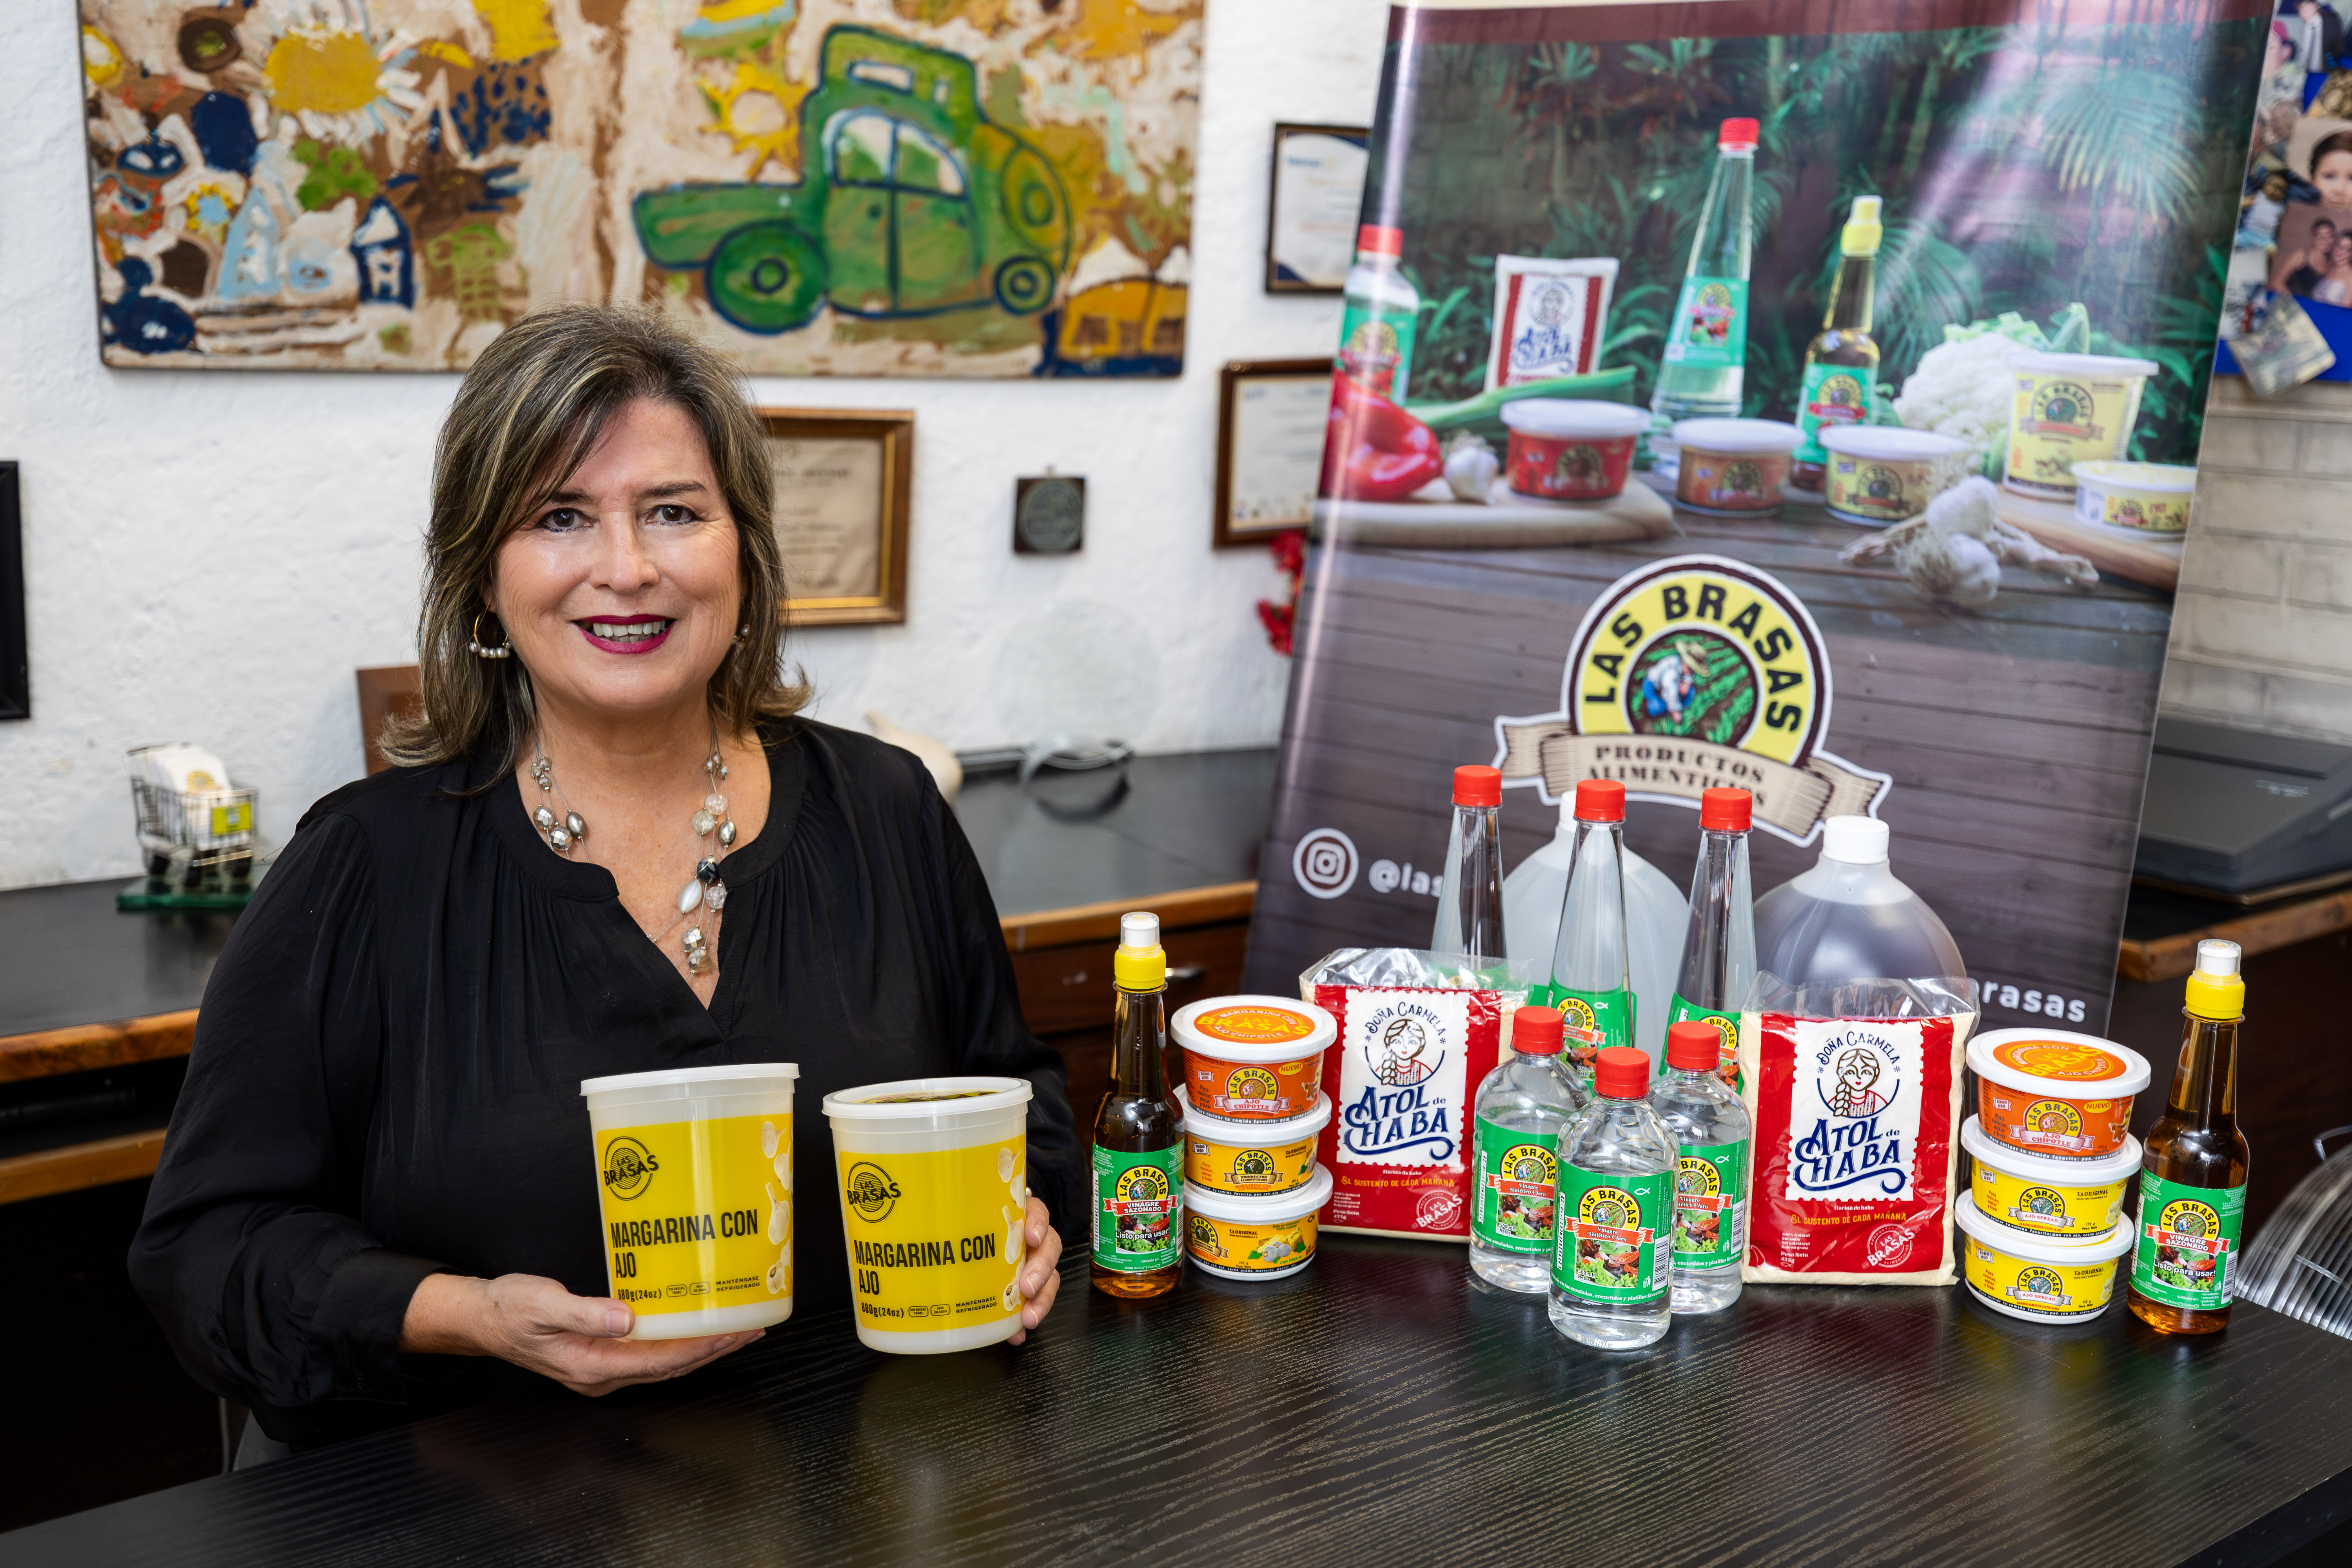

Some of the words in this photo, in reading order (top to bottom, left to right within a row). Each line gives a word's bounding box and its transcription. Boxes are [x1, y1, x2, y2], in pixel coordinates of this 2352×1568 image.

[1586, 613, 1643, 703] LAS
[1662, 584, 1803, 732] BRASAS
[1596, 745, 1765, 783] PRODUCTOS
[1197, 1016, 1310, 1035] BRASAS
[1220, 1010, 1281, 1018] MARGARINA
[1282, 1015, 1297, 1025] CON
[1365, 1007, 1394, 1034] DOÑA
[1398, 1002, 1446, 1036] CARMELA
[1213, 1025, 1229, 1034] AJO
[1710, 1019, 1735, 1044] BRASAS
[1816, 1038, 1843, 1065] DOÑA
[1846, 1031, 1901, 1064] CARMELA
[1281, 1064, 1302, 1073] NUEVO
[2020, 1046, 2105, 1076] BRASAS
[1230, 1076, 1241, 1094] LAS
[1244, 1070, 1275, 1095] BRASAS
[1345, 1085, 1430, 1128] ATOL
[2028, 1107, 2042, 1126] LAS
[2045, 1103, 2078, 1132] BRASAS
[1344, 1107, 1450, 1149] HABA
[1795, 1117, 1882, 1160] ATOL
[2031, 1136, 2071, 1147] CHIPOTLE
[604, 1154, 659, 1187] BRASAS
[617, 1156, 631, 1167] LAS
[1237, 1156, 1246, 1171] LAS
[1247, 1152, 1272, 1171] BRASAS
[1504, 1153, 1517, 1174] LAS
[1521, 1148, 1555, 1180] BRASAS
[1795, 1140, 1901, 1183] HABA
[859, 1180, 874, 1190] LAS
[1120, 1176, 1132, 1196] LAS
[1134, 1169, 1167, 1195] BRASAS
[1681, 1161, 1717, 1192] BRASAS
[846, 1182, 902, 1205] BRASAS
[2022, 1193, 2033, 1207] LAS
[2034, 1190, 2062, 1213] BRASAS
[1416, 1194, 1463, 1228] BRASAS
[1429, 1201, 1442, 1211] LAS
[1582, 1195, 1595, 1218] LAS
[1598, 1190, 1637, 1224] BRASAS
[1791, 1214, 1801, 1224] EL
[1804, 1217, 1840, 1225] SUSTENTO
[1853, 1214, 1871, 1223] CADA
[1874, 1210, 1907, 1221] MAÑANA
[611, 1214, 715, 1248] MARGARINA
[721, 1209, 758, 1238] CON
[1991, 1215, 2004, 1224] cocinar
[2163, 1207, 2178, 1227] LAS
[2181, 1203, 2216, 1235] BRASAS
[1115, 1230, 1133, 1240] Listo
[1134, 1231, 1152, 1240] para
[1153, 1227, 1171, 1238] usar!
[1880, 1236, 1893, 1247] LAS
[2169, 1234, 2207, 1245] VINAGRE
[854, 1240, 956, 1268] MARGARINA
[960, 1232, 996, 1263] CON
[1867, 1228, 1915, 1267] BRASAS
[2166, 1239, 2209, 1252] SAZONADO
[615, 1252, 637, 1279] AJO
[2153, 1259, 2172, 1272] Listo
[2173, 1265, 2194, 1276] para
[715, 1276, 759, 1285] MANTÉNGASE
[716, 1282, 760, 1292] REFRIGERADO
[858, 1268, 880, 1296] AJO
[2020, 1272, 2031, 1287] LAS
[2033, 1269, 2059, 1292] BRASAS
[618, 1288, 662, 1303] 680g(24oz)
[956, 1296, 996, 1307] MANTÉNGASE
[1570, 1287, 1594, 1298] ensaladas,
[1647, 1289, 1664, 1298] favoritos.
[861, 1302, 904, 1319] 680g(24oz)
[956, 1302, 997, 1314] REFRIGERADO
